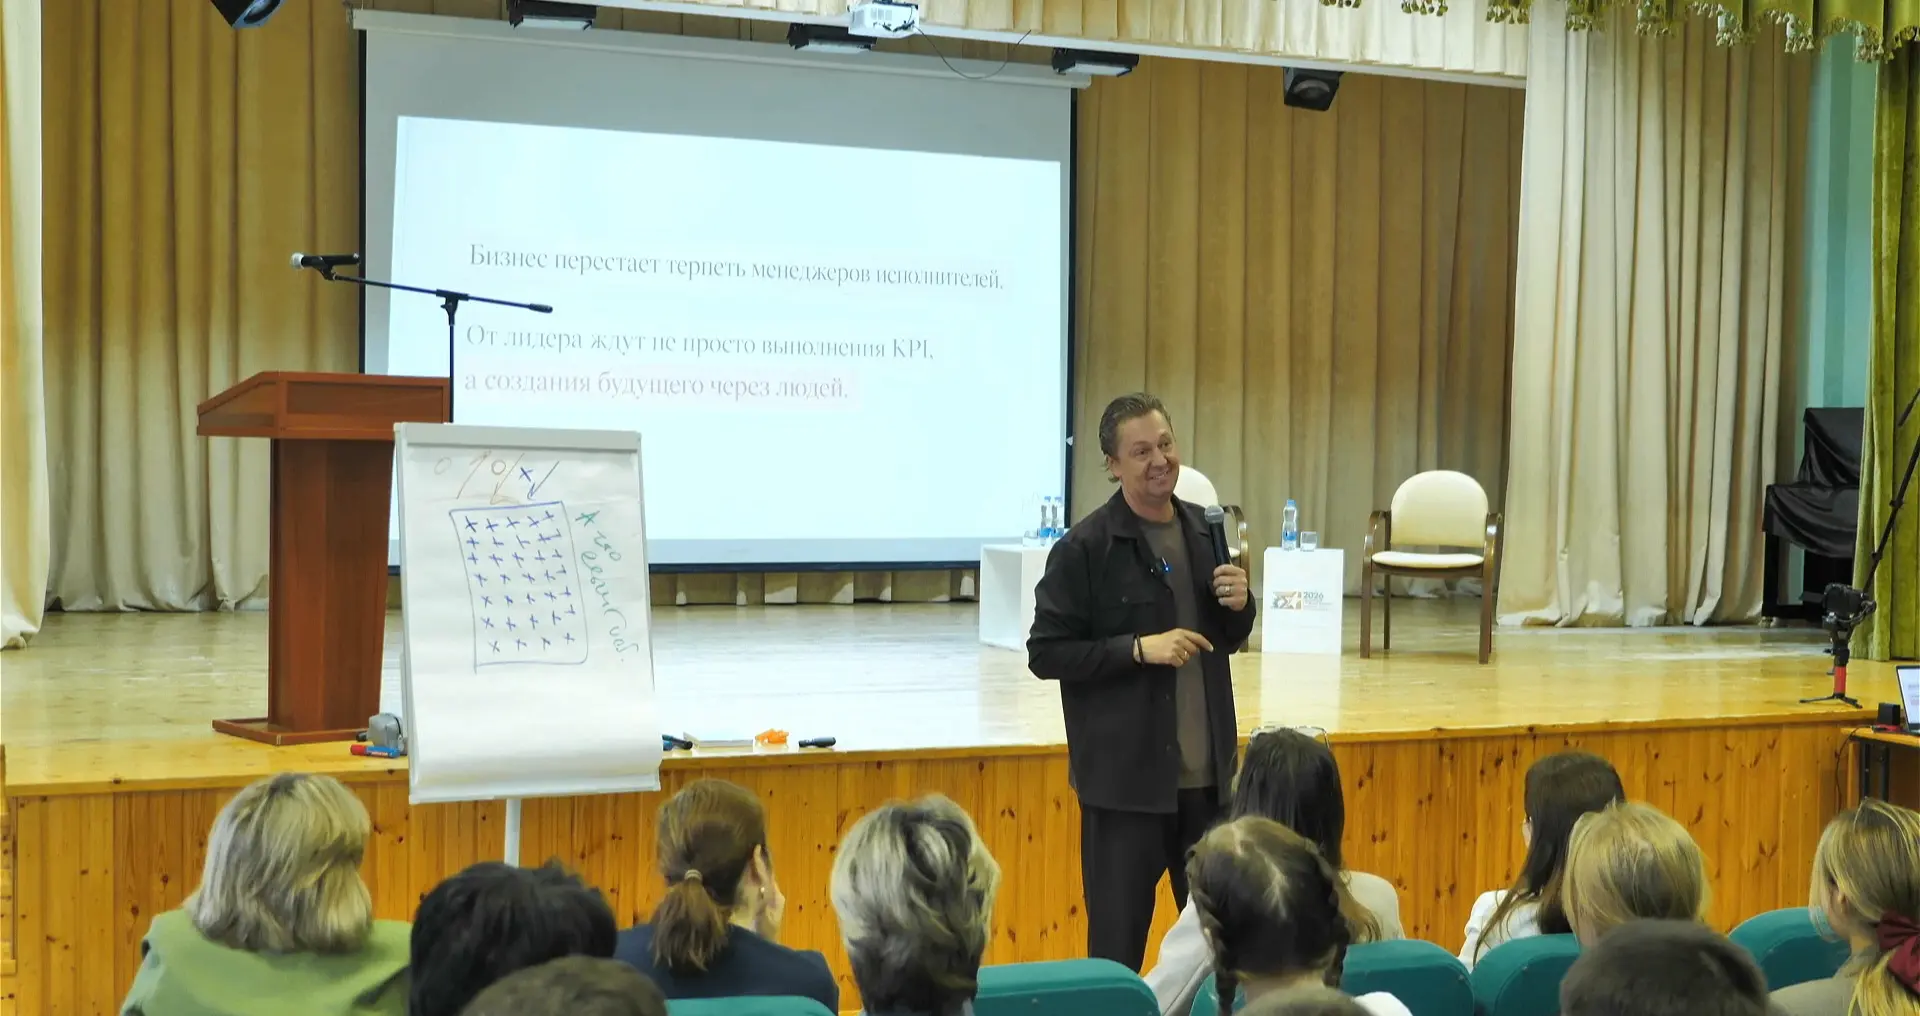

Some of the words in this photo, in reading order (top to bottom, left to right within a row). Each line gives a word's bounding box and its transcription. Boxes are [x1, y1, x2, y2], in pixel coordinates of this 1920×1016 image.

[469, 243, 548, 268] Бизнес
[555, 251, 661, 275] перестает
[666, 258, 746, 281] терпеть
[751, 262, 871, 287] менеджеров
[876, 266, 1004, 290] исполнителей.
[466, 324, 498, 346] От
[503, 332, 582, 353] лидера
[590, 332, 647, 355] ждут
[652, 334, 677, 352] не
[683, 334, 756, 357] просто
[762, 339, 886, 358] выполнения
[892, 337, 934, 360] KPI,
[464, 374, 477, 391] а
[484, 373, 591, 394] создания
[598, 371, 704, 400] будущего
[710, 378, 770, 401] через
[775, 377, 849, 400] людей.
